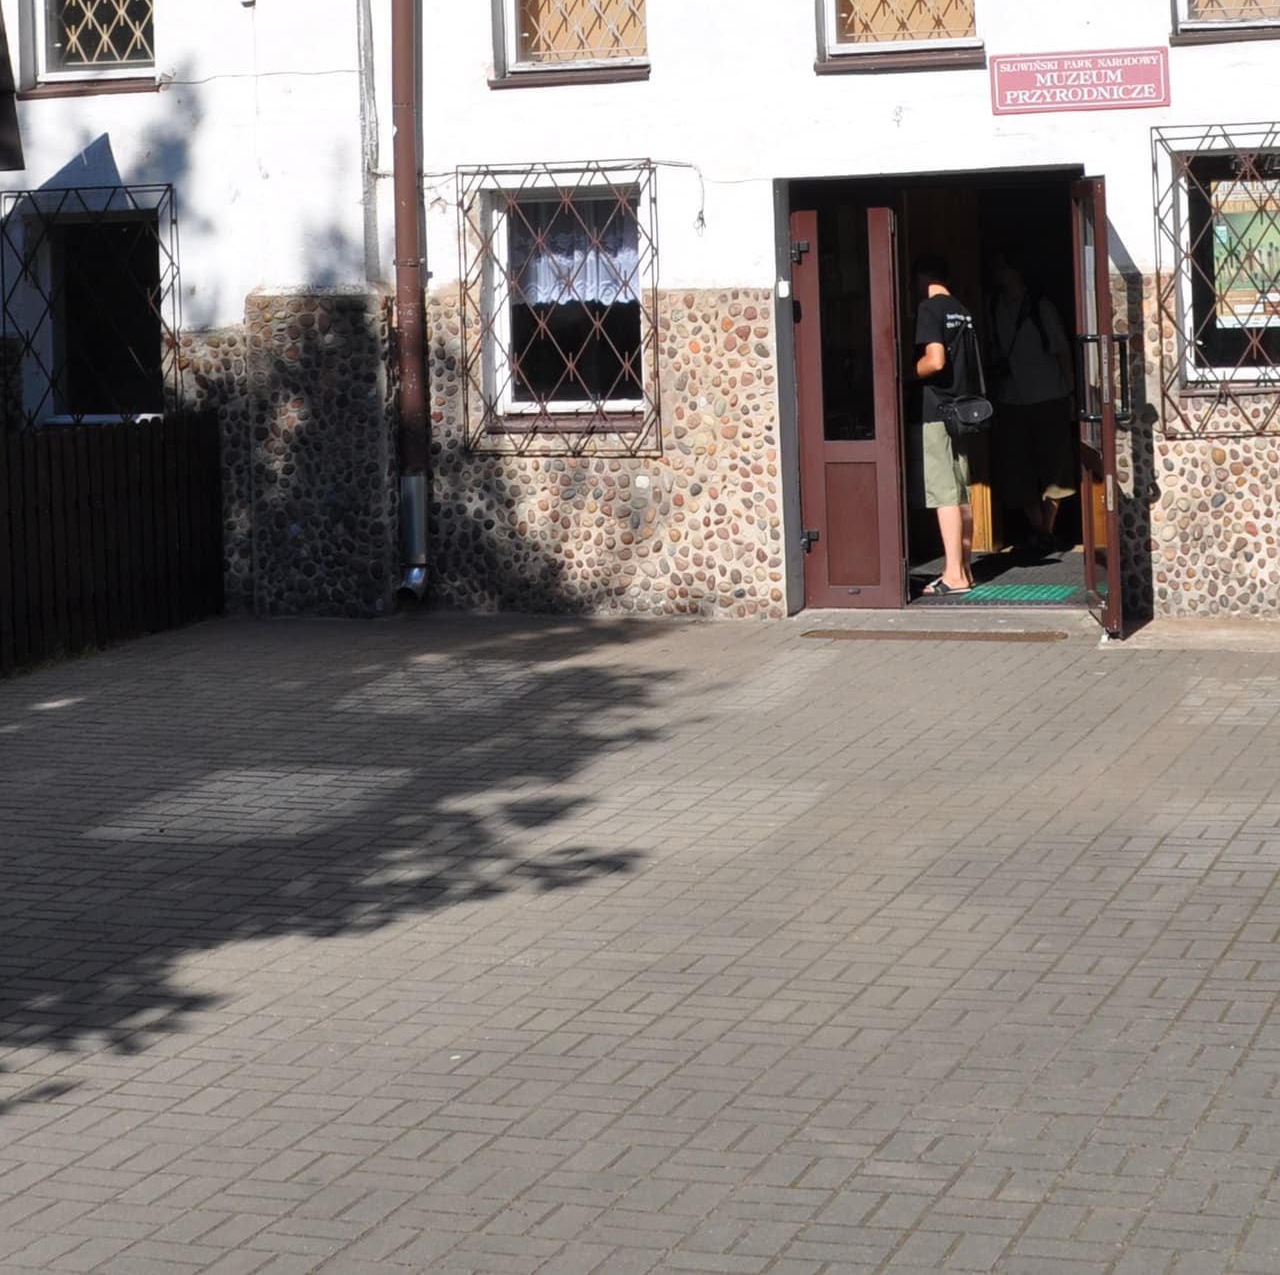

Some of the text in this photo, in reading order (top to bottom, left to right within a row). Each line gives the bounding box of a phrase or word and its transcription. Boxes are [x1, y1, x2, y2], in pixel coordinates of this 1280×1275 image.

[1064, 59, 1093, 70] PARK
[1098, 56, 1158, 67] NARODOWY
[1035, 69, 1123, 87] MUZEUM
[1005, 84, 1156, 105] PRZYRODNICZE
